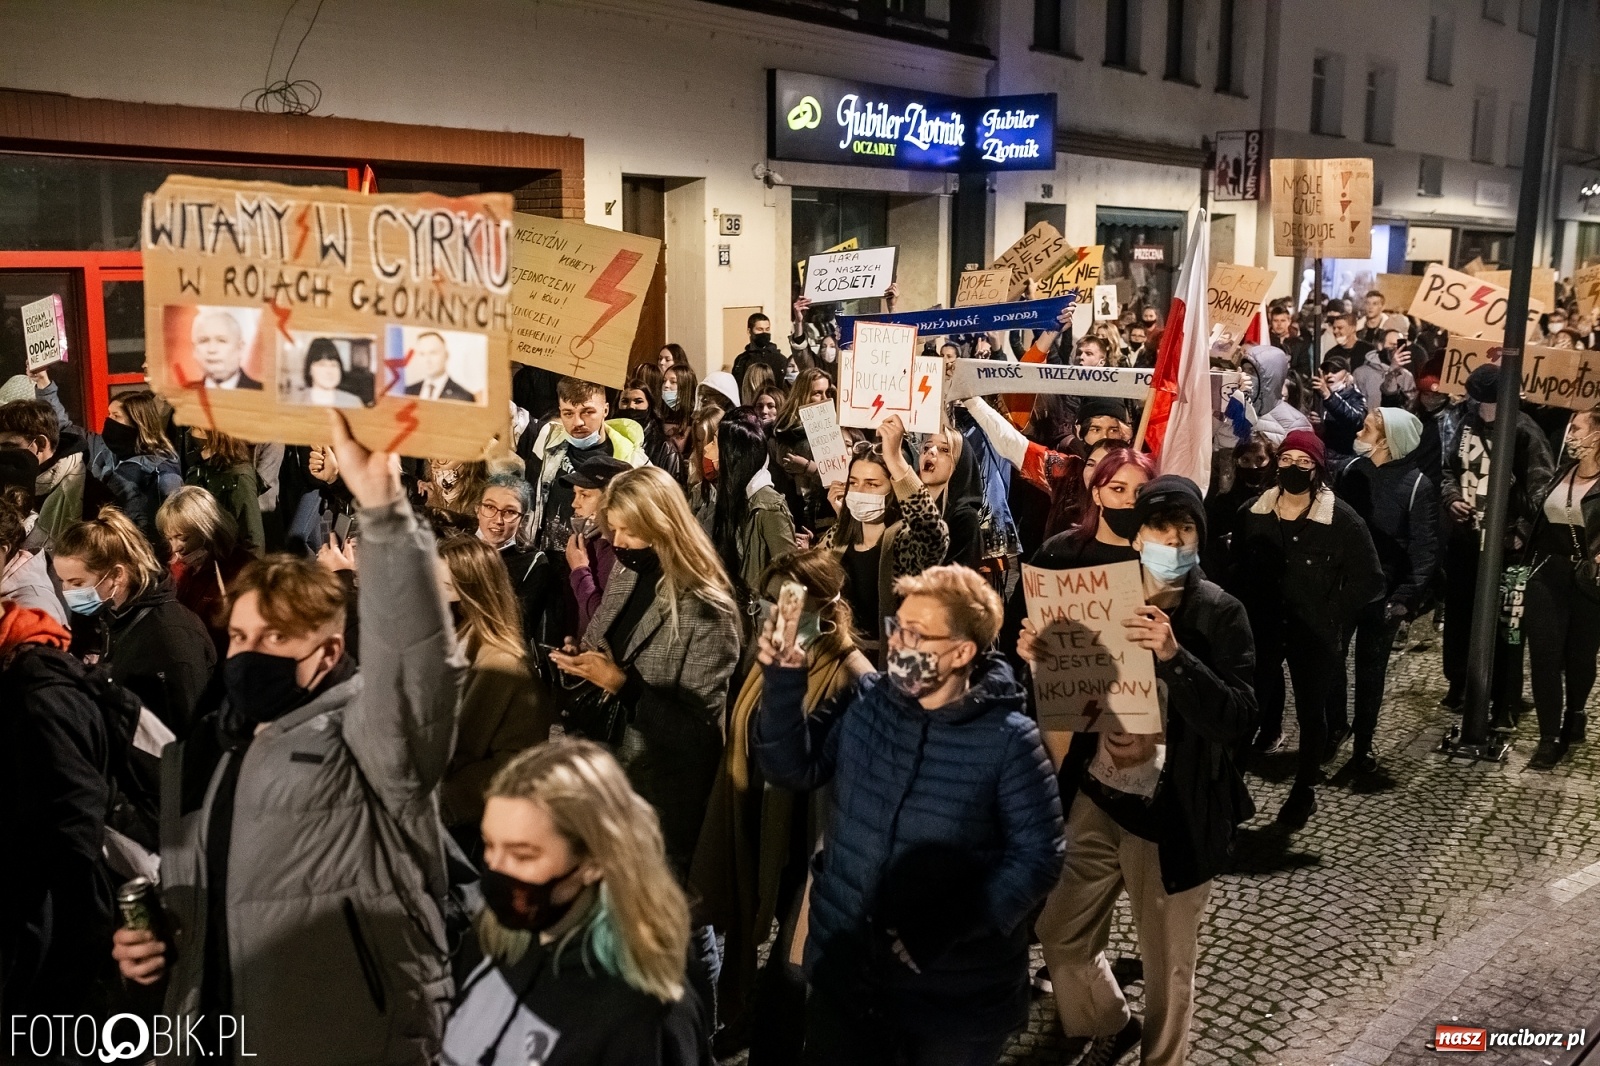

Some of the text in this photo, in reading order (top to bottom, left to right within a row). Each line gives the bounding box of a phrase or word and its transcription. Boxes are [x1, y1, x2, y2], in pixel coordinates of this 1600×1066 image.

[837, 94, 965, 150] Jubiler Złotnik
[983, 109, 1039, 138] Jubiler
[983, 138, 1039, 163] Złotnik
[726, 218, 740, 231] 36
[142, 192, 513, 295] WITAMY W CYRKU
[1013, 228, 1042, 254] MEN
[558, 254, 597, 274] KOBIETY
[813, 268, 828, 277] OD
[835, 264, 881, 274] NASZYCH
[1075, 262, 1100, 285] NIE
[177, 267, 200, 296] W
[224, 265, 332, 307] ROLACH
[814, 274, 876, 293] KOBIET!
[1216, 266, 1234, 286] To
[529, 290, 538, 300] W
[958, 289, 999, 302] CIAŁO
[1423, 273, 1467, 311] PiS
[25, 311, 47, 327] KOCHAM
[26, 317, 54, 335] ROZUMIEM
[28, 336, 56, 356] ODDAĆ
[860, 328, 911, 344] STRACH
[30, 347, 59, 366] NIE UMIEM
[926, 363, 938, 374] NA
[977, 364, 1024, 379] MIŁOŚĆ
[1036, 366, 1119, 383] TRZEŹWOŚĆ
[818, 455, 842, 476] CIPKI
[1024, 570, 1109, 599] NIE MAM
[1040, 598, 1113, 627] MACICY
[1046, 651, 1125, 672] JESTEM
[1037, 680, 1152, 701] WKURWIONY
